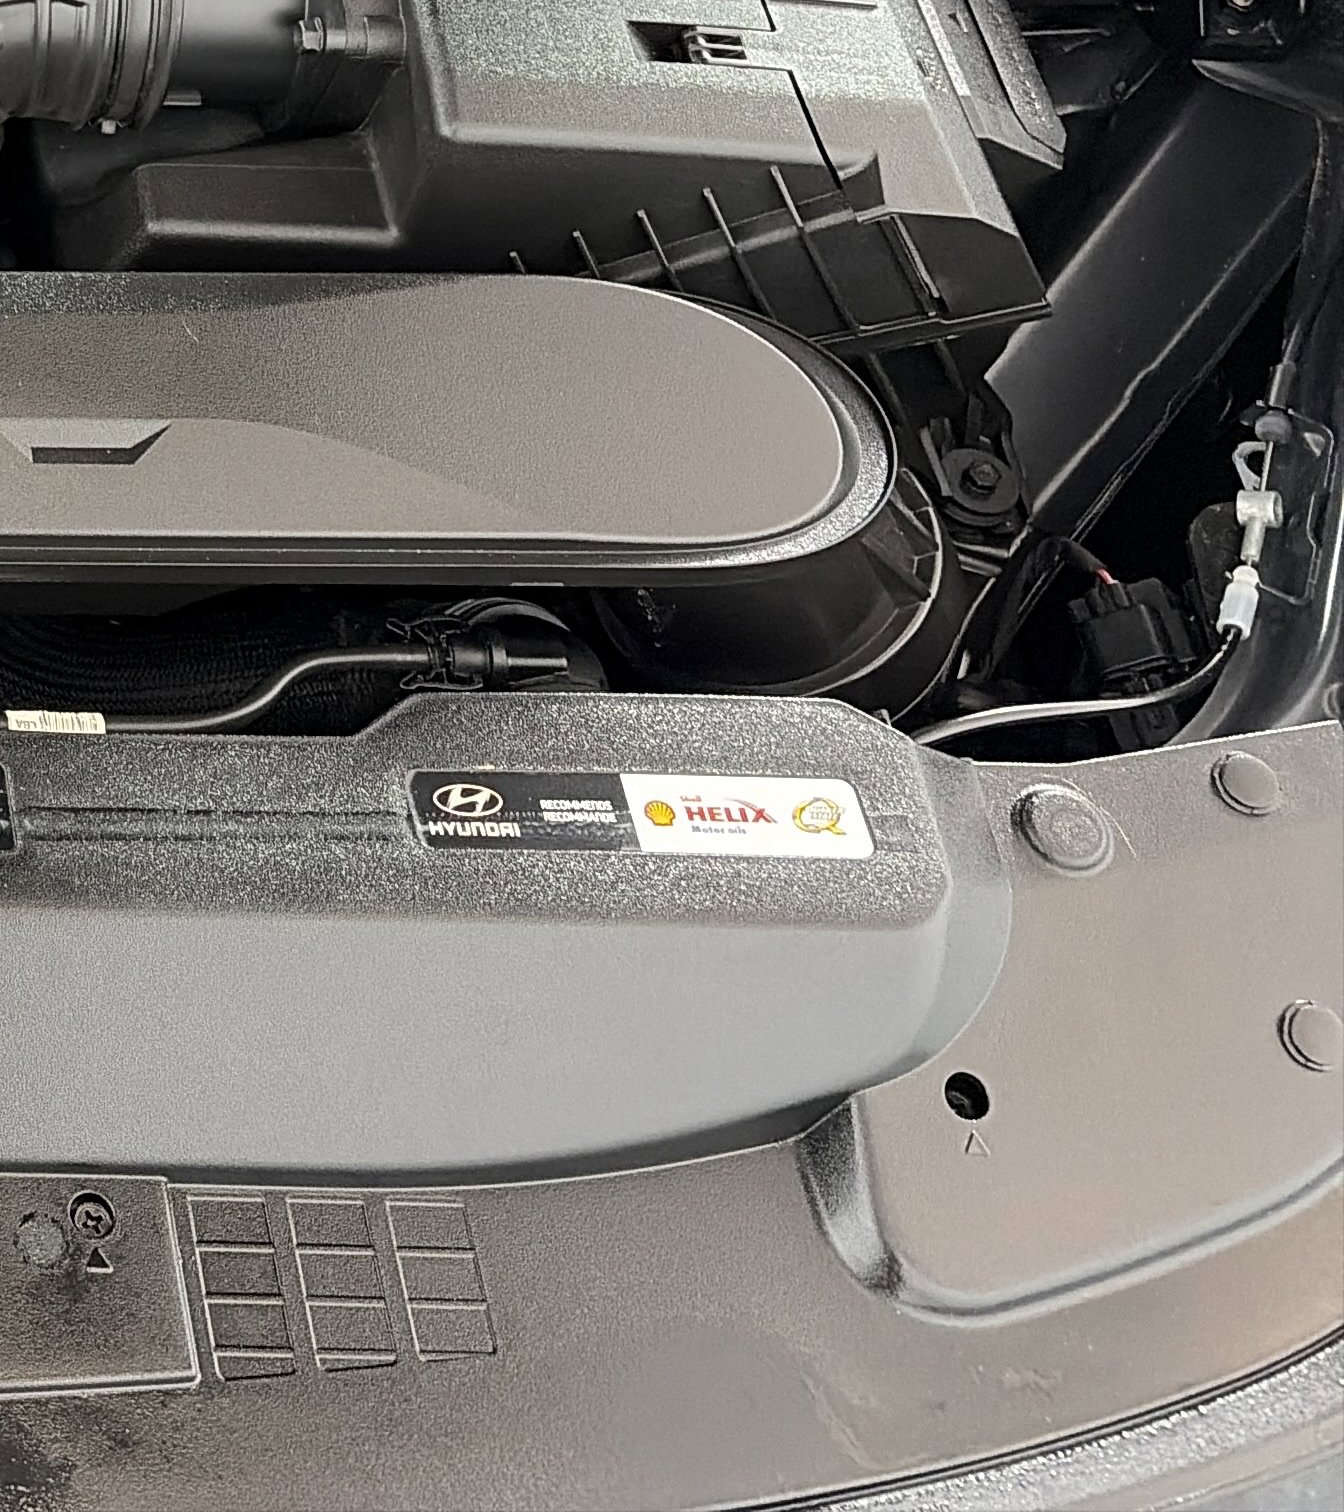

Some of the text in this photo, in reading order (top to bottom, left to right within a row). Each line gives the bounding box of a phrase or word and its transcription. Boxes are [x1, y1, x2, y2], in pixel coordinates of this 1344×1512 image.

[539, 799, 613, 811] RECOMMENDS
[684, 805, 774, 824] HELIX
[427, 820, 522, 838] HYUNDAI
